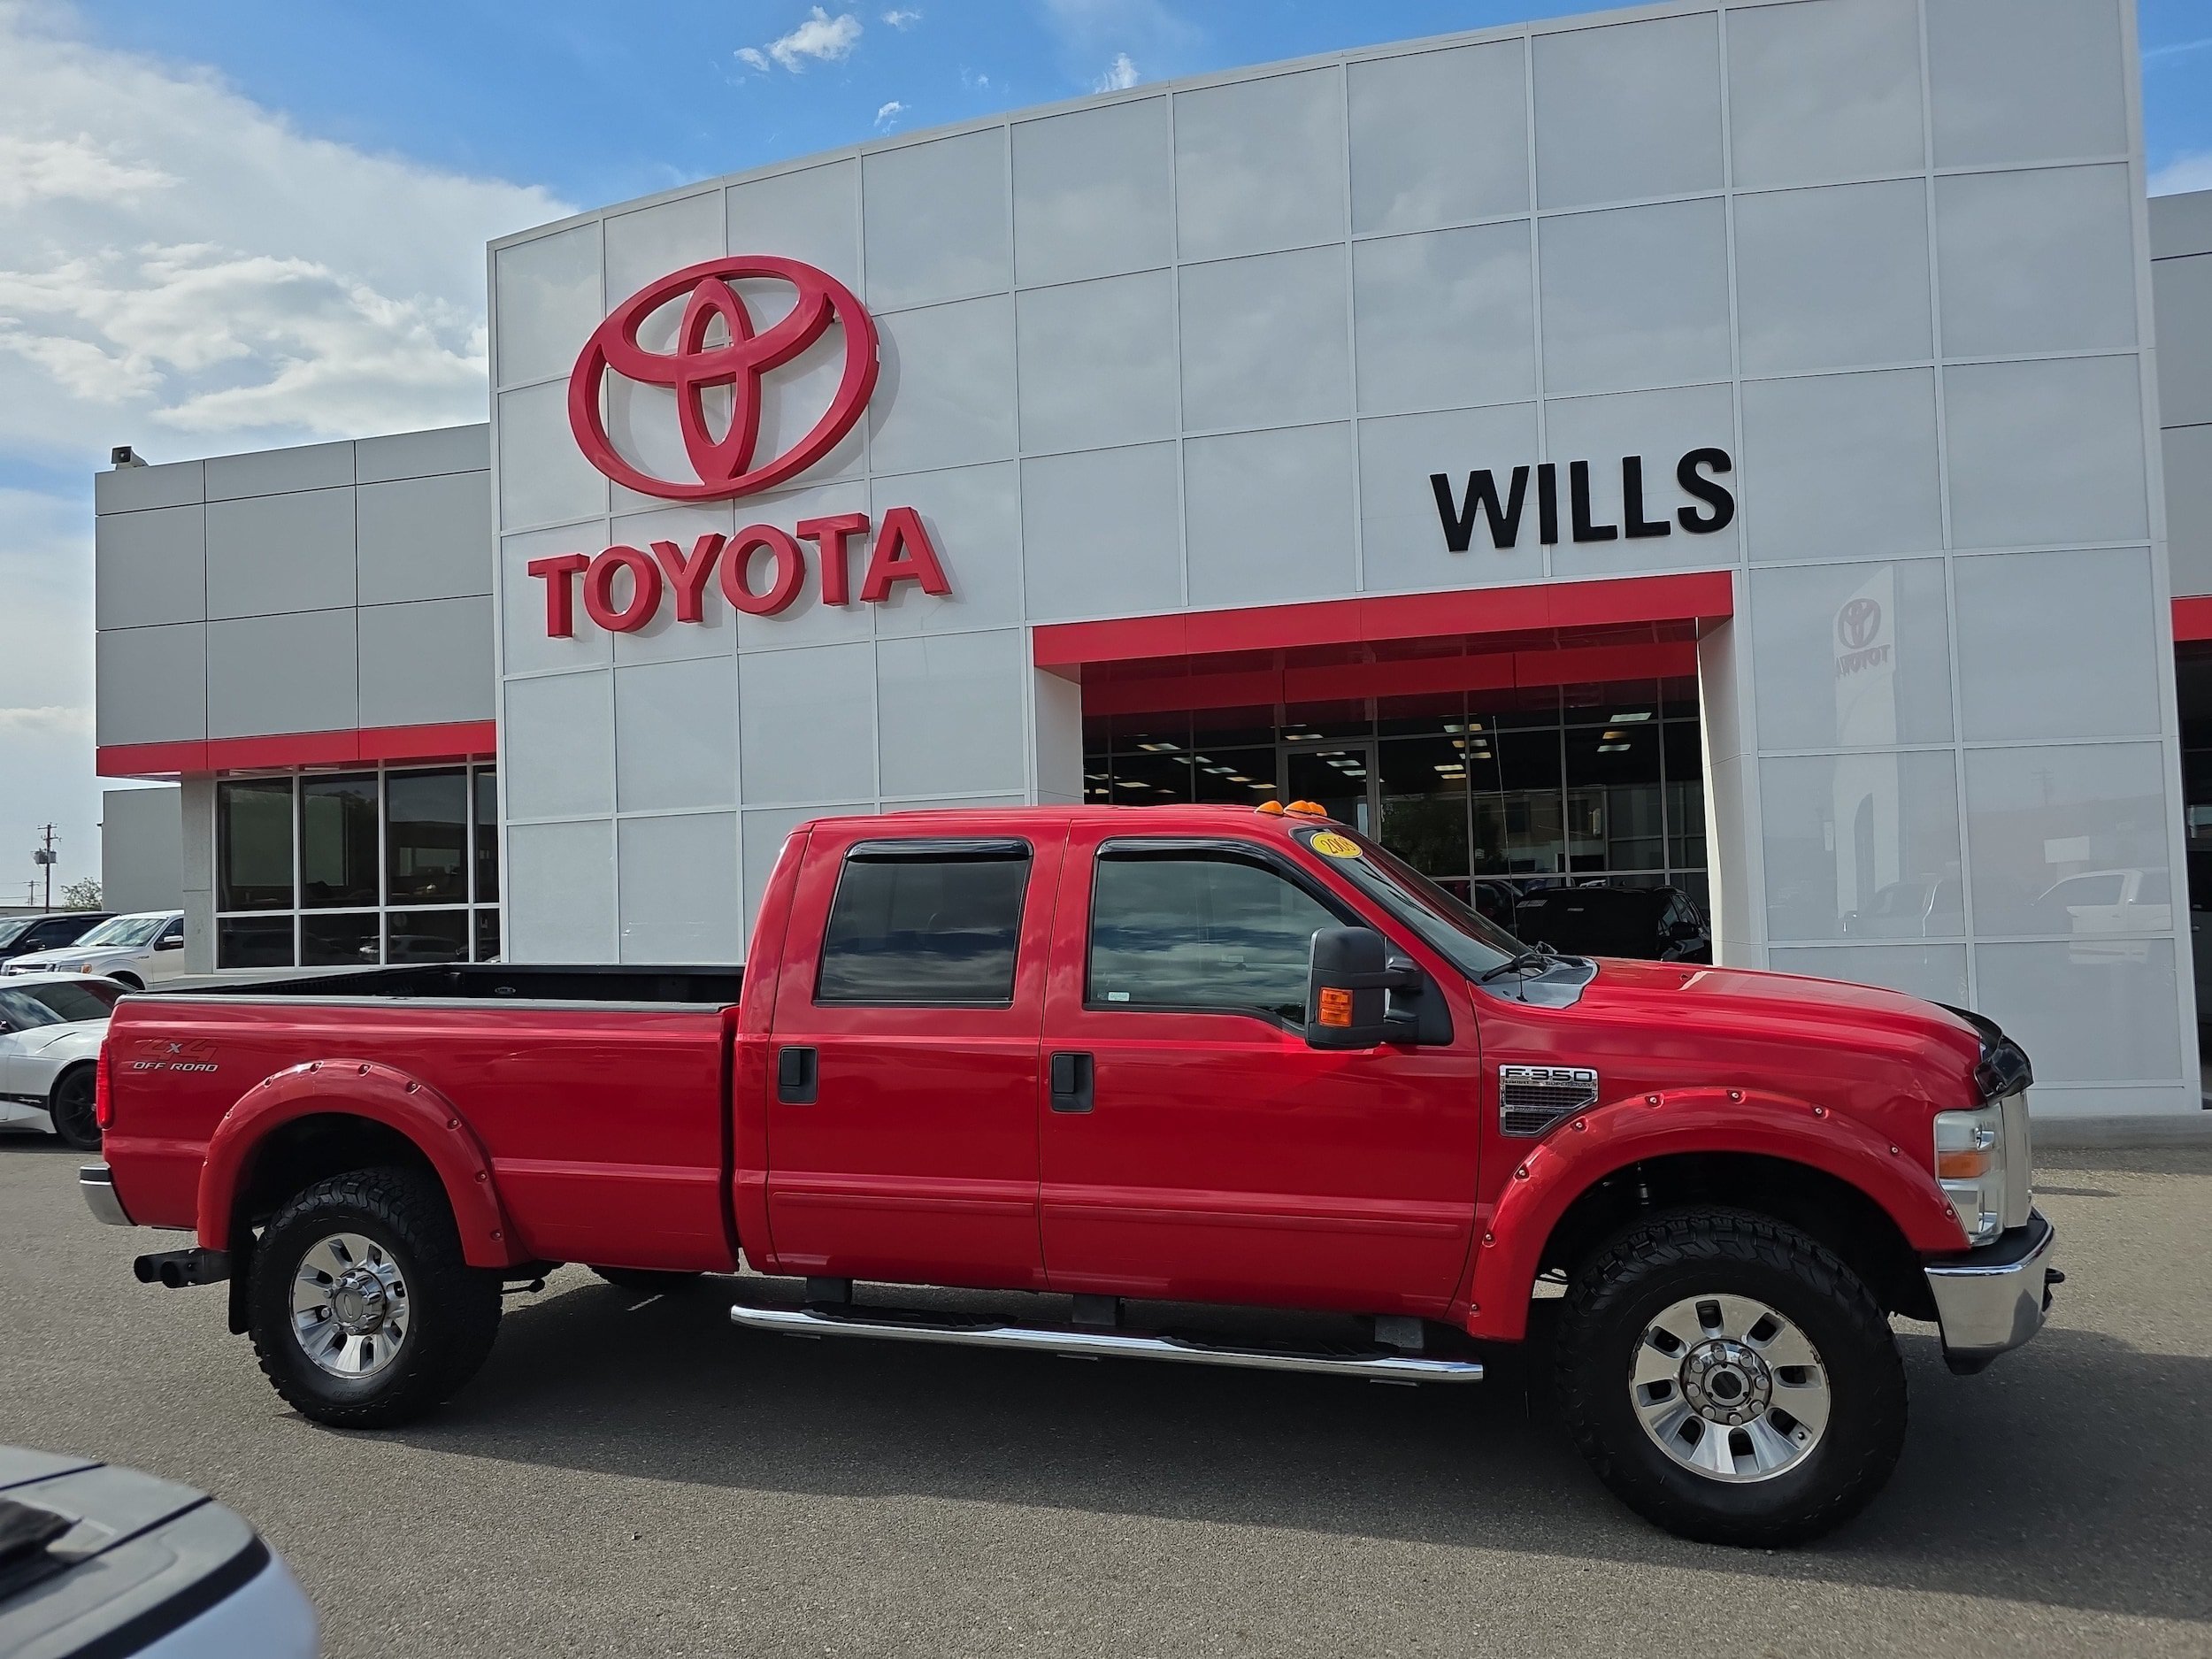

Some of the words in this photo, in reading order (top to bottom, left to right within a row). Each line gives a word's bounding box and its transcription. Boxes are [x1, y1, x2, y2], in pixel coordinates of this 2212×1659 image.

[1430, 447, 1735, 552] WILLS
[527, 506, 952, 638] TOYOTA
[170, 1063, 219, 1072] ROAD
